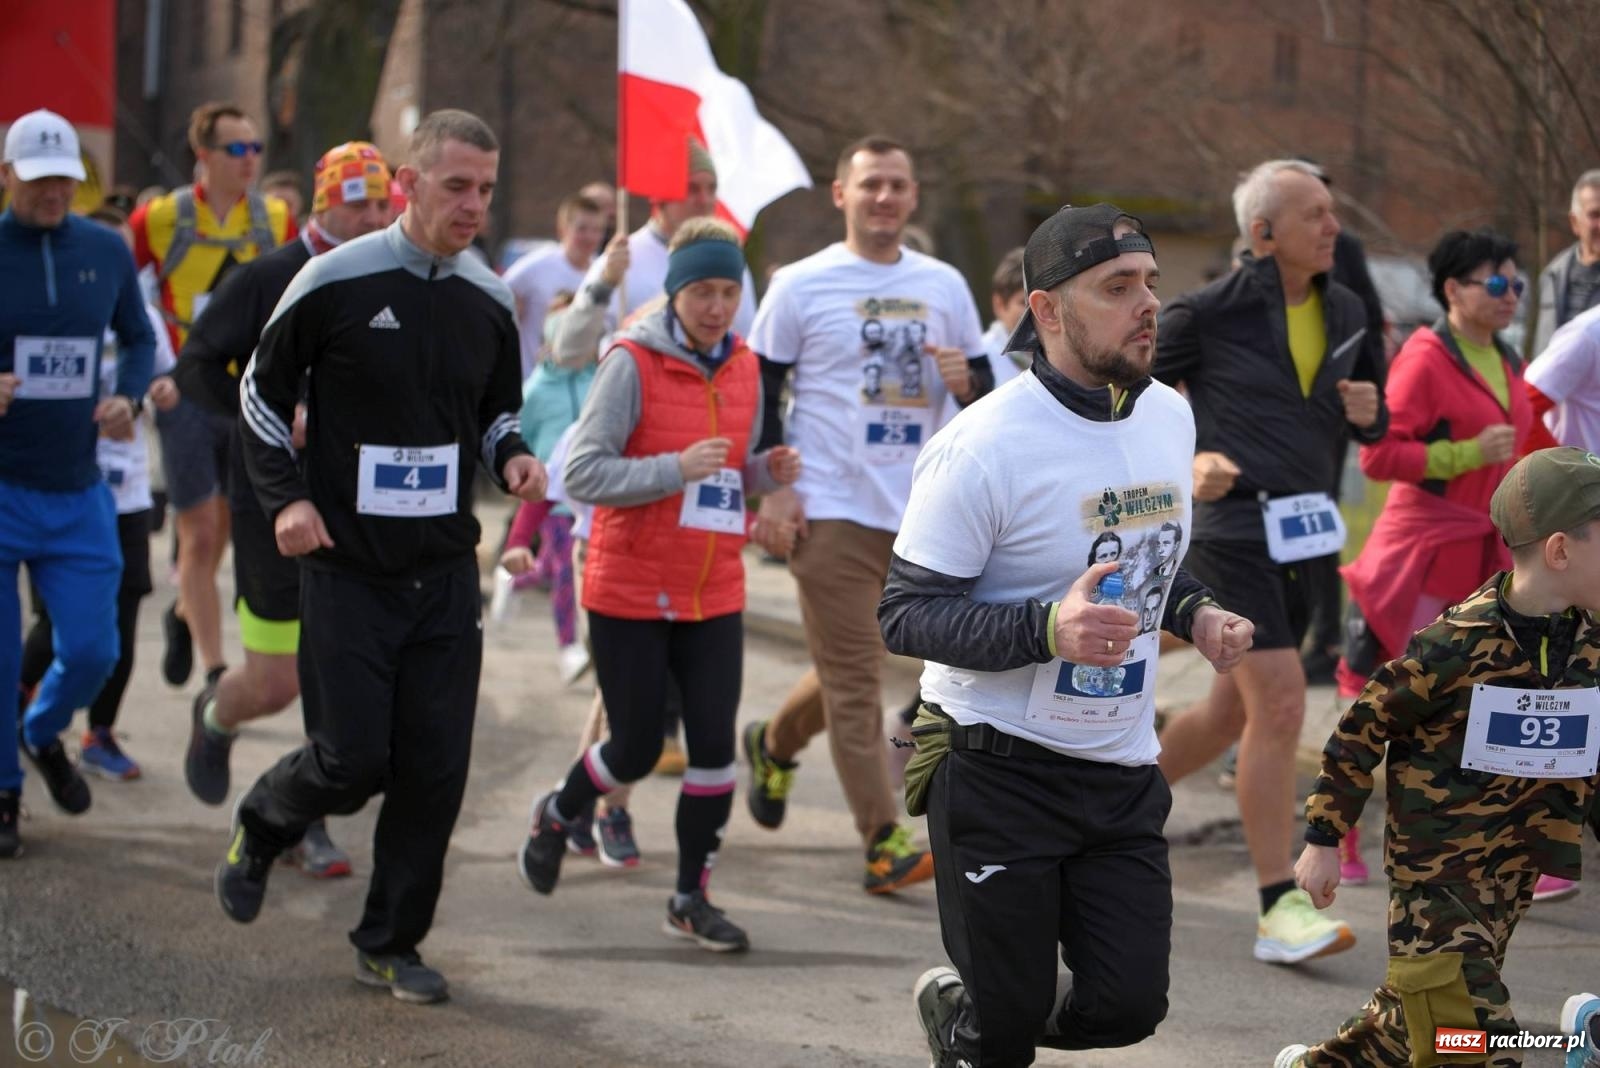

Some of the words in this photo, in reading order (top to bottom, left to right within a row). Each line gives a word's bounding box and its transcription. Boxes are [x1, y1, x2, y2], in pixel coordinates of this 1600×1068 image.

[882, 424, 908, 444] 25
[403, 467, 421, 489] 4
[719, 487, 732, 509] 3
[1123, 487, 1149, 500] TROPEM
[1125, 493, 1173, 516] WILCZYM
[1300, 513, 1322, 534] 11
[1535, 700, 1570, 711] WILCZYM
[1520, 717, 1561, 746] 93
